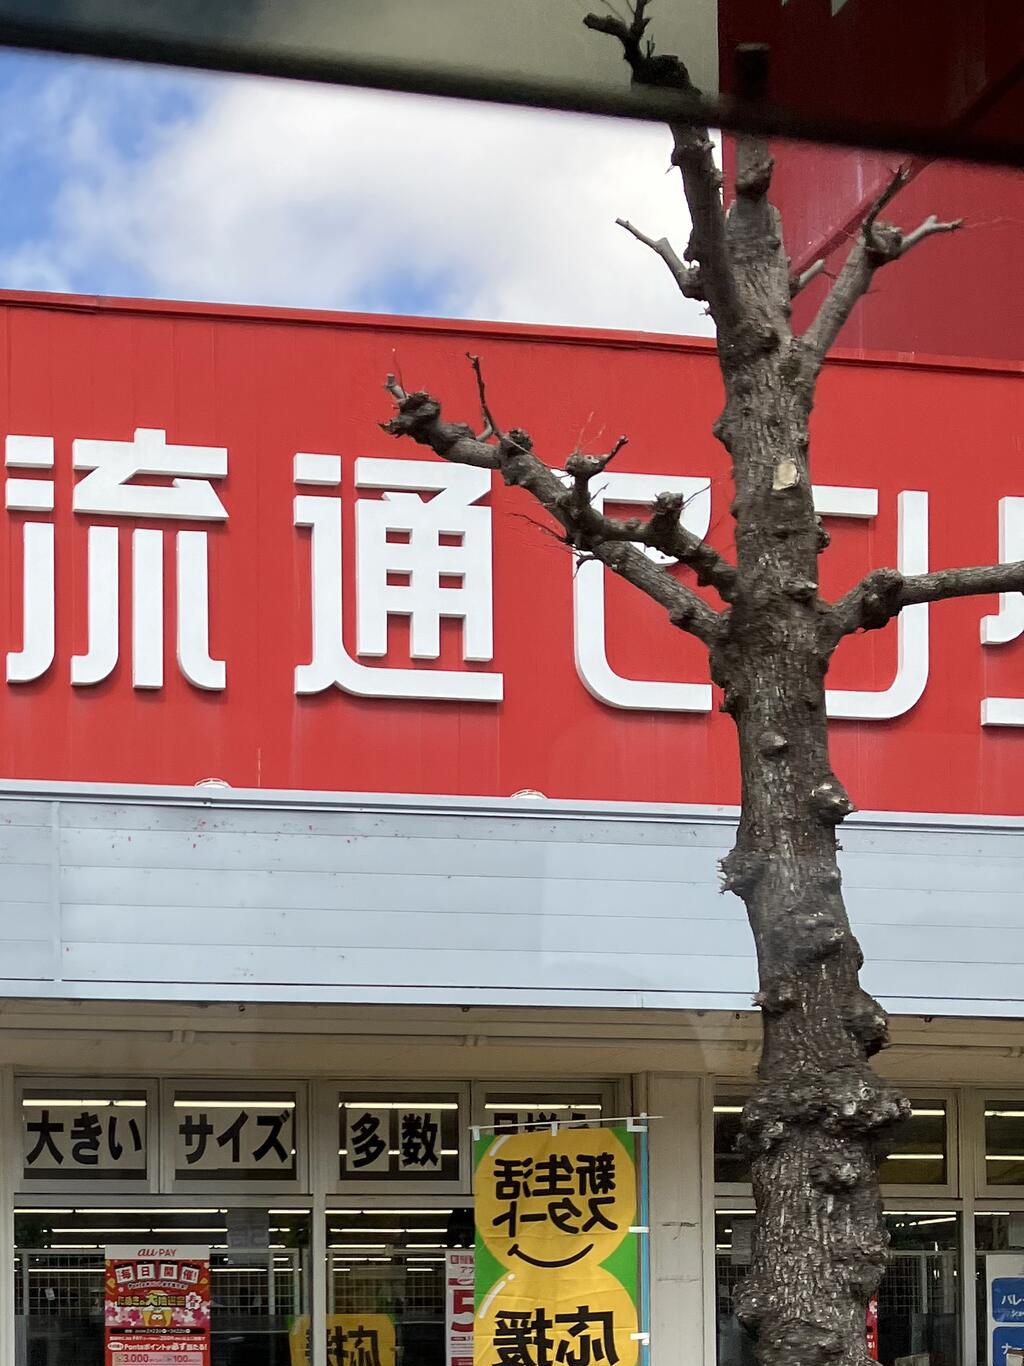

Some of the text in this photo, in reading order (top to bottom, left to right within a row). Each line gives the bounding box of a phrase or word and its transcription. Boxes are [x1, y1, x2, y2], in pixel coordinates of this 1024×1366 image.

[26, 1109, 440, 1169] 大きい サイズ 多数
[159, 1248, 177, 1257] PAY
[1000, 1294, 1024, 1306] バレ
